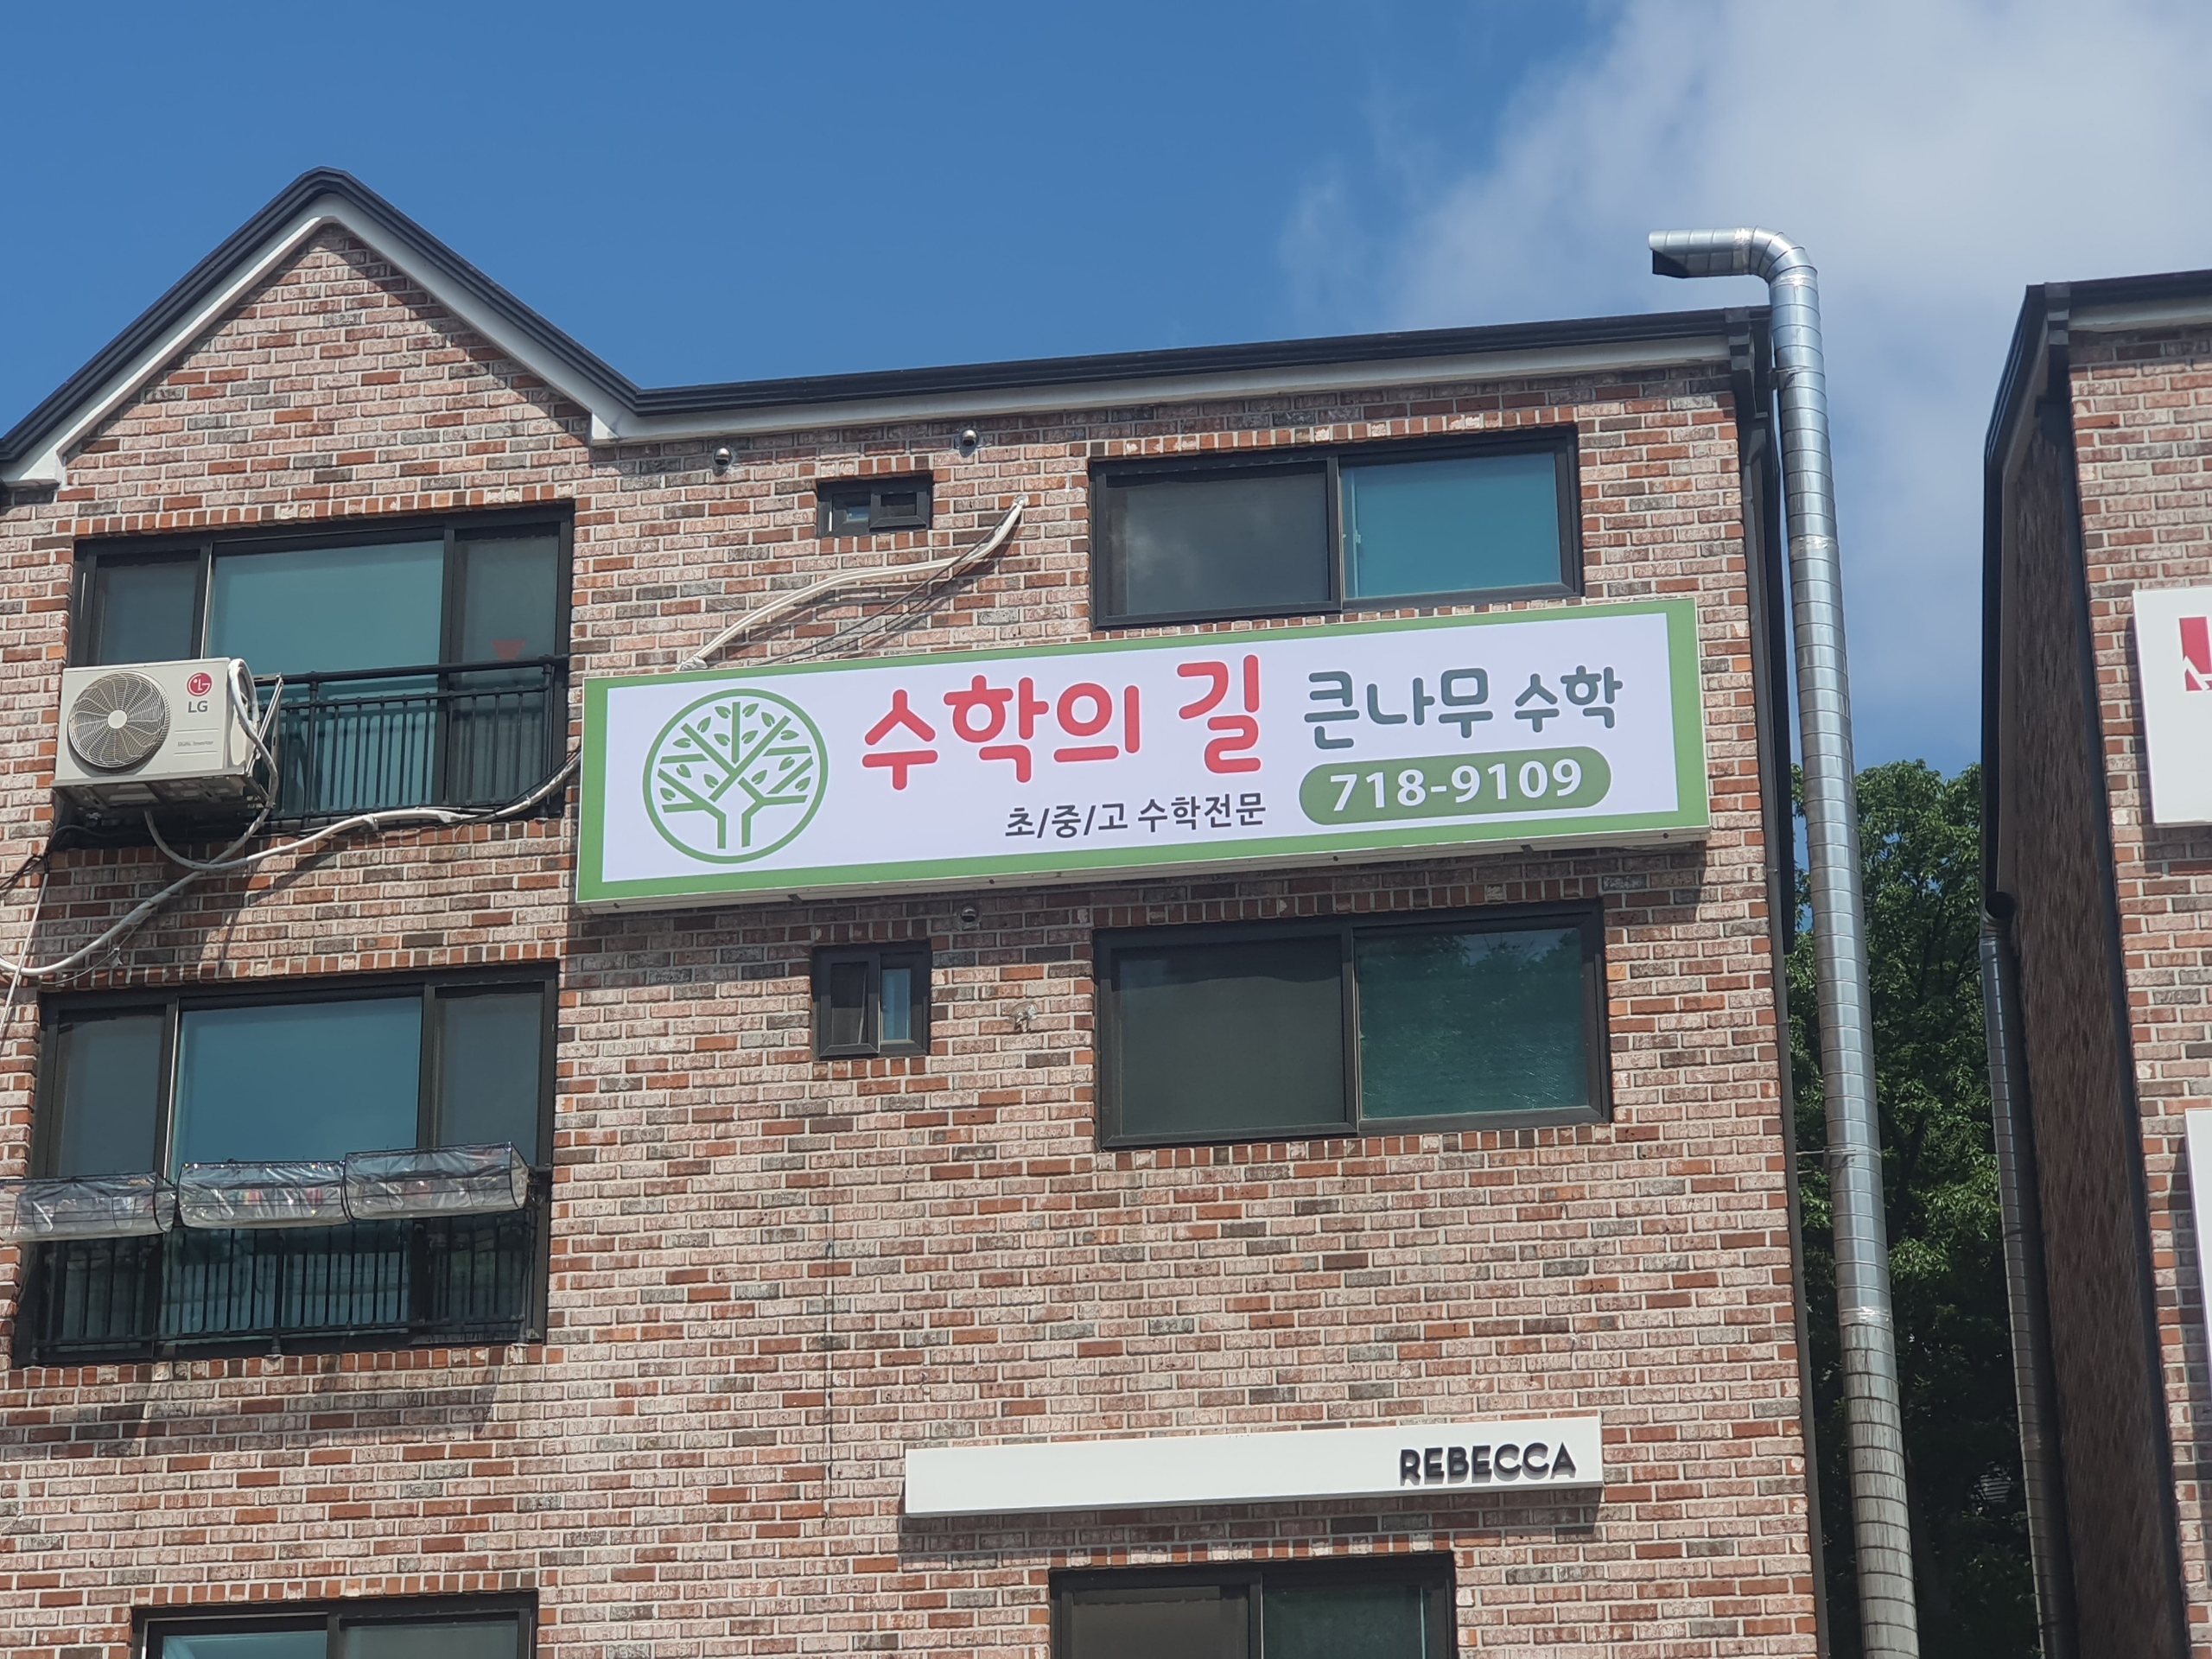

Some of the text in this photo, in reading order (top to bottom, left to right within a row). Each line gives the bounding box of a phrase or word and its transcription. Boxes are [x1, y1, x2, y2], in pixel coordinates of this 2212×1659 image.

[188, 701, 208, 713] LG
[862, 654, 1262, 791] 수학의 길
[1304, 664, 1623, 749] 큰나무 수학
[1330, 758, 1582, 811] 718-9109
[1005, 792, 1267, 839] 초/중/고 수학전문
[1400, 1441, 1577, 1479] REBECCA
